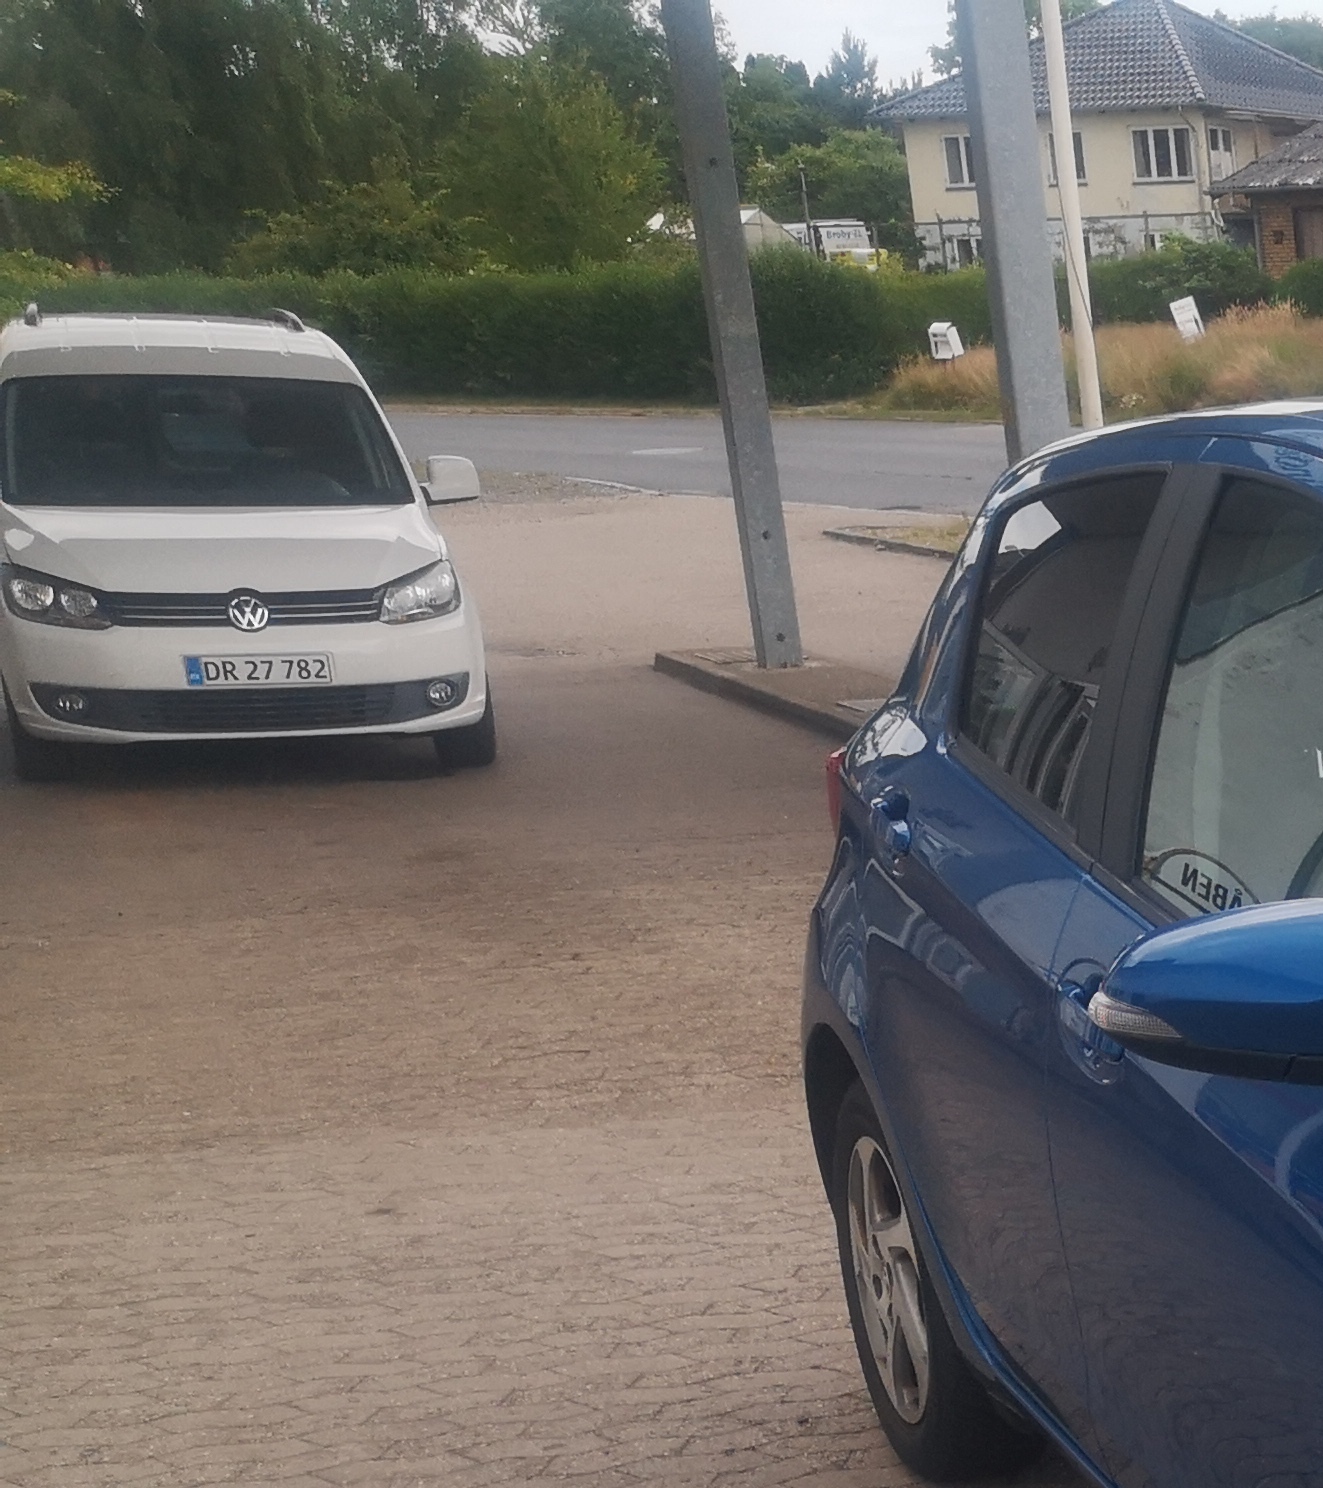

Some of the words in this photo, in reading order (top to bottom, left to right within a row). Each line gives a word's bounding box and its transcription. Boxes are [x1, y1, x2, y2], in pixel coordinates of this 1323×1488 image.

[203, 660, 239, 681] DR
[244, 660, 273, 681] 27
[281, 658, 328, 680] 782
